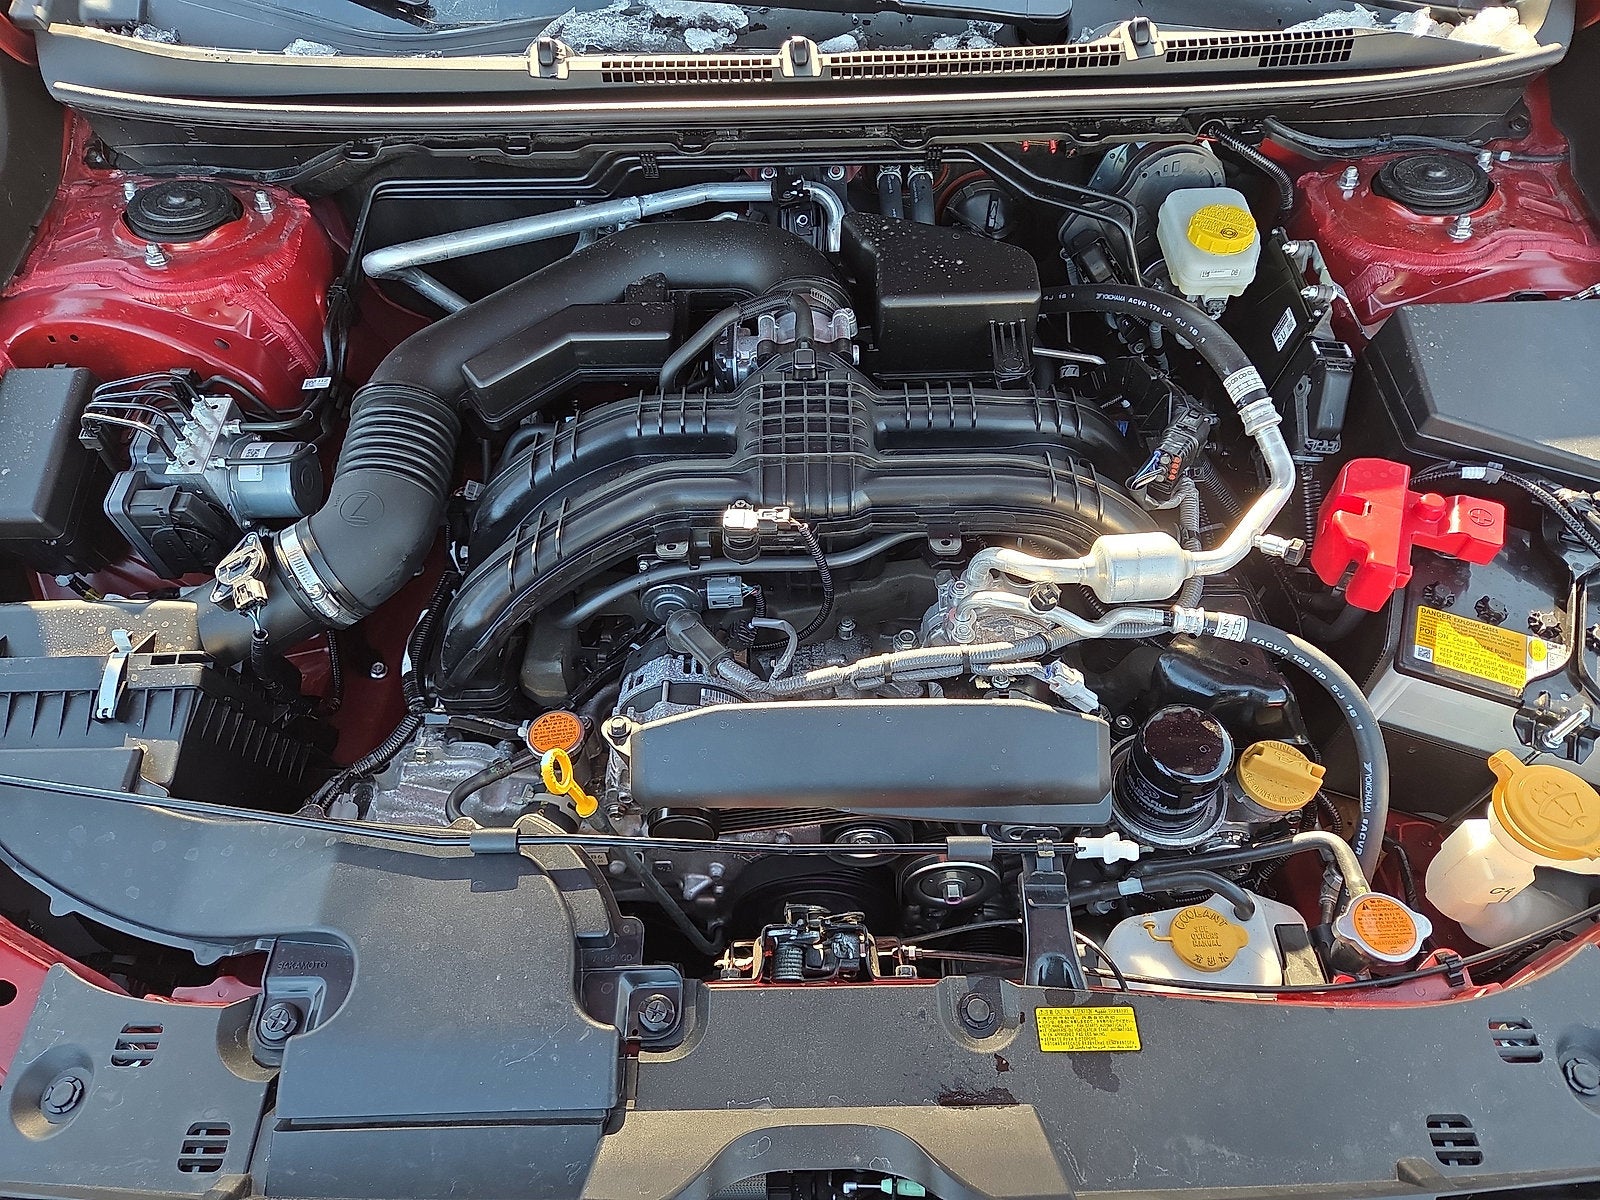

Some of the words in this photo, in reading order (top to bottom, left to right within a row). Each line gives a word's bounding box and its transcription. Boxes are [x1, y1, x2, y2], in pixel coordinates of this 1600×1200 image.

[1162, 310, 1173, 318] LP
[1421, 607, 1452, 620] DANGER
[1419, 626, 1449, 640] POISON
[1312, 667, 1327, 680] HP
[1364, 770, 1373, 813] YOKOHAMA
[1174, 908, 1228, 930] COOLANT
[1193, 925, 1209, 933] SEE
[277, 960, 329, 970] SAKAMOTO
